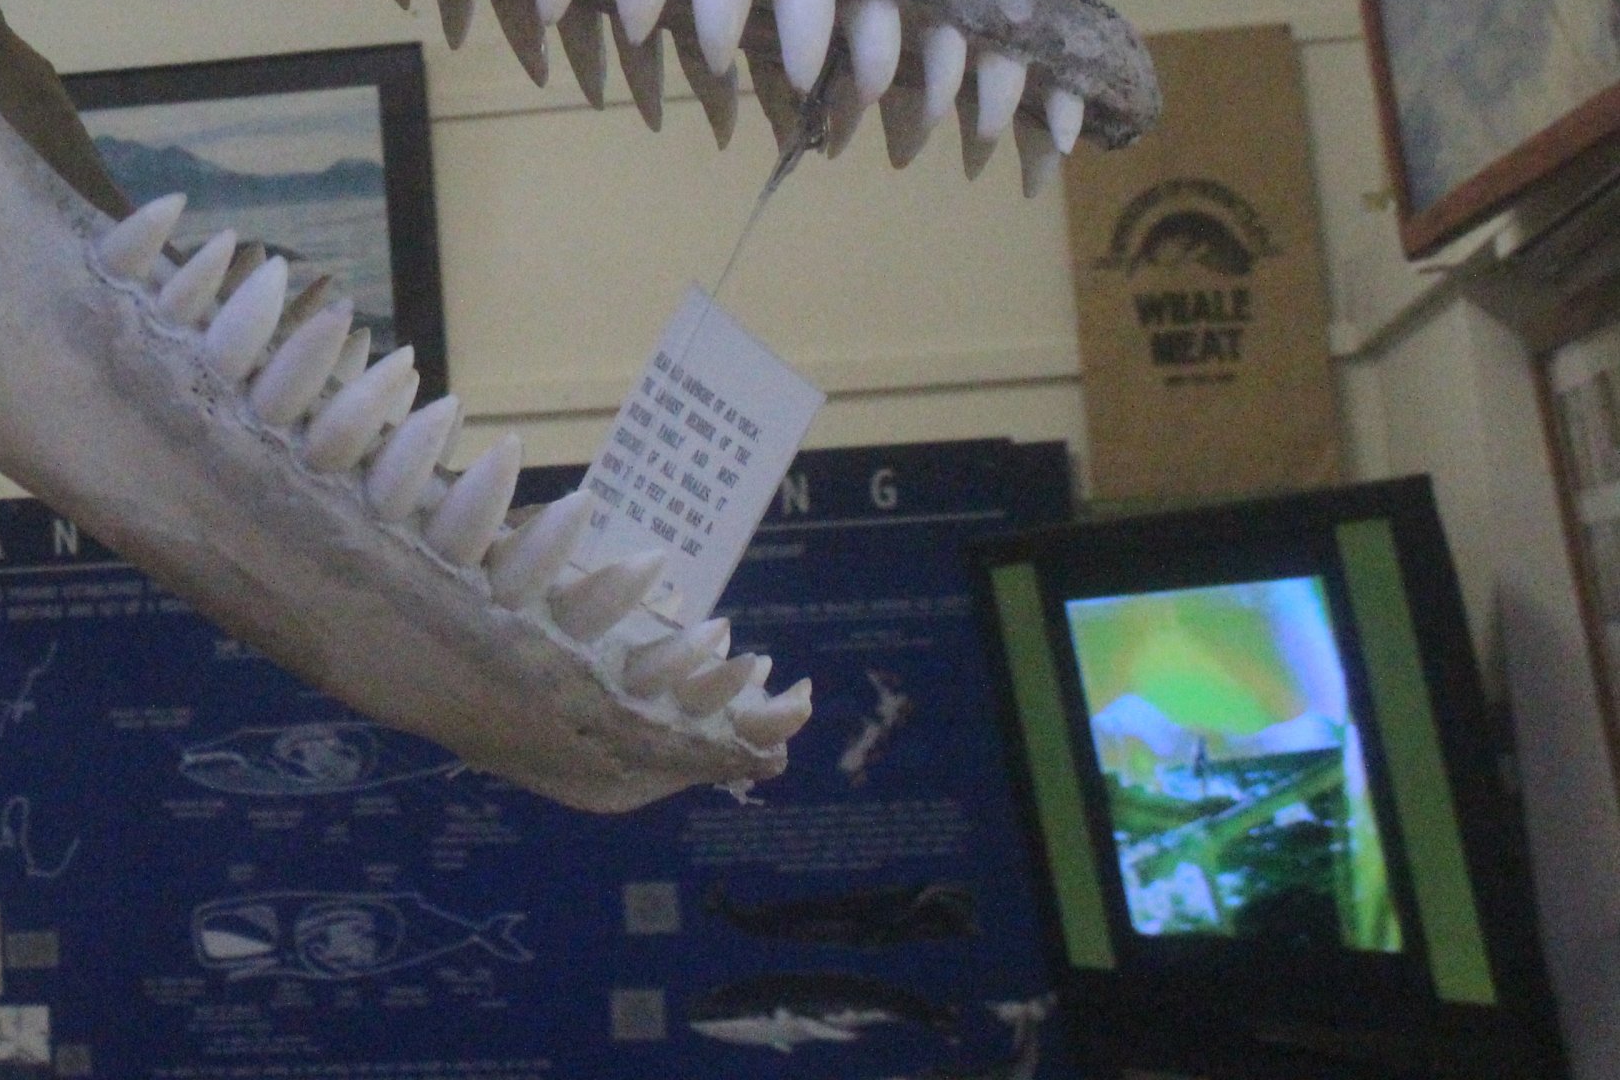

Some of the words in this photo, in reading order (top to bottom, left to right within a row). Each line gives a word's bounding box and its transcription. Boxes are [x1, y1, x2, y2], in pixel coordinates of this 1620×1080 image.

[1136, 289, 1252, 325] WHALE
[1151, 328, 1244, 367] MEAT
[640, 376, 655, 395] THE
[685, 411, 716, 440] MEMBER
[718, 434, 732, 451] OF
[733, 445, 751, 465] THE
[712, 398, 725, 414] OF
[723, 406, 738, 423] AN
[656, 422, 685, 451] FAMILY
[690, 448, 709, 468] AND
[716, 465, 739, 489] MOST
[646, 449, 659, 465] OF
[660, 458, 678, 479] ALL
[714, 495, 728, 512] IT
[625, 500, 646, 523] TALL
[645, 481, 666, 504] FEET
[666, 495, 685, 516] AND
[684, 508, 703, 528] HAS
[703, 520, 714, 535] A
